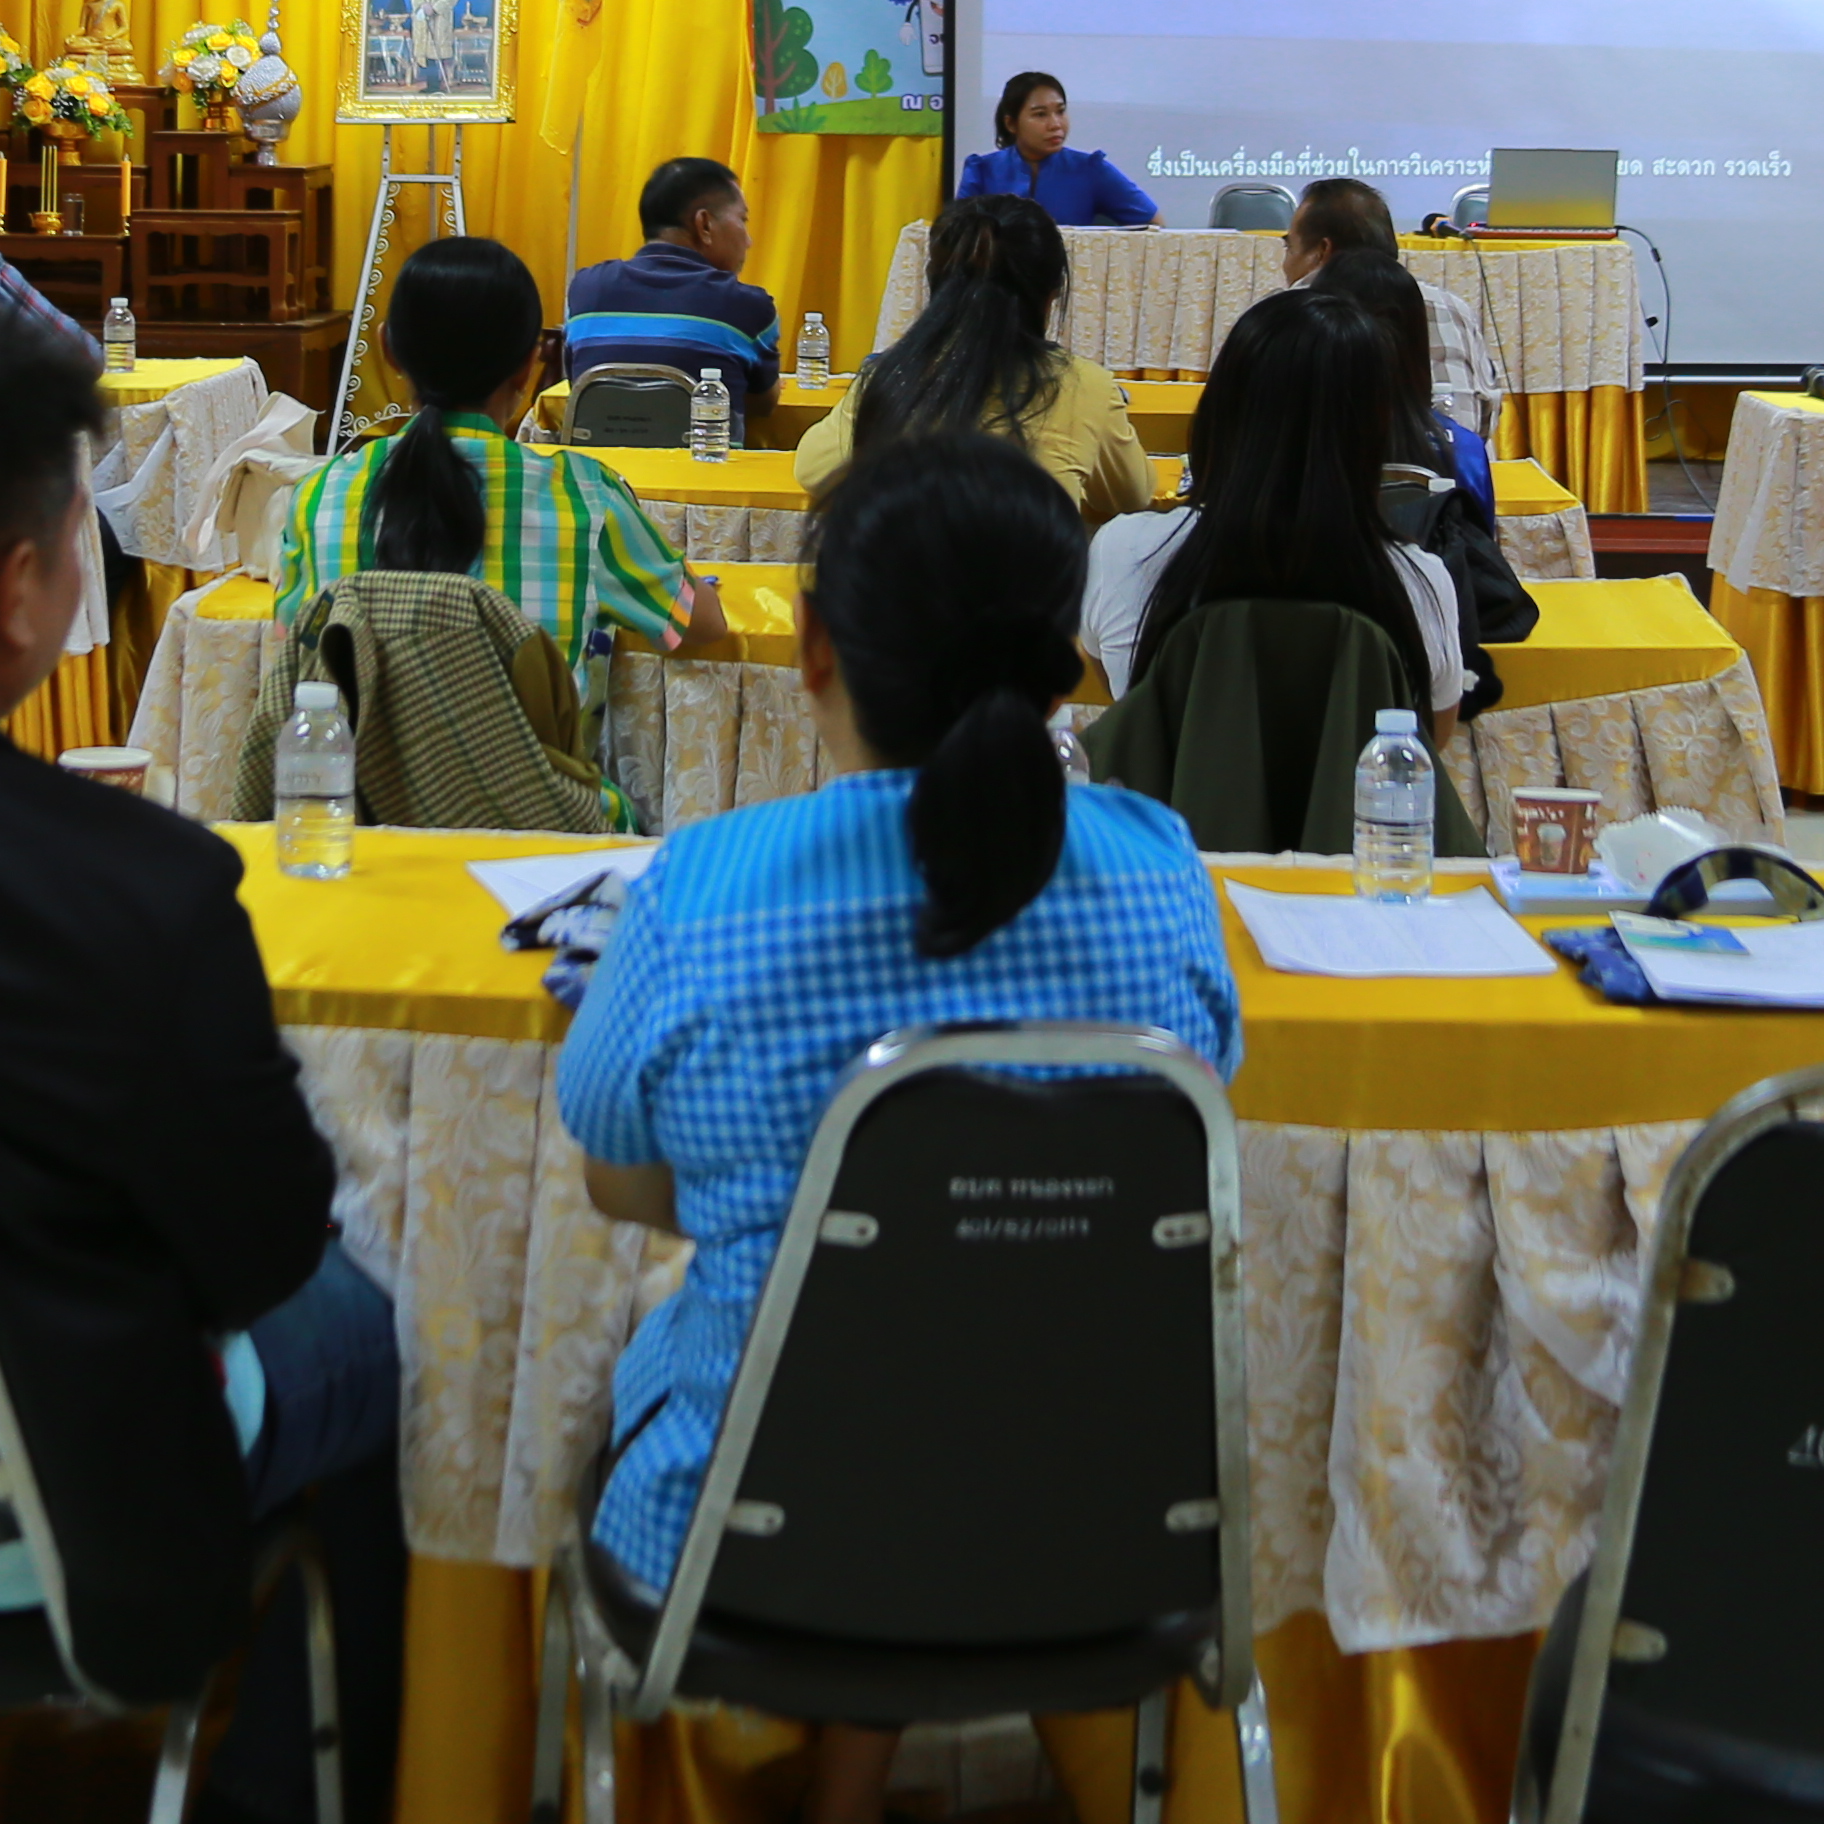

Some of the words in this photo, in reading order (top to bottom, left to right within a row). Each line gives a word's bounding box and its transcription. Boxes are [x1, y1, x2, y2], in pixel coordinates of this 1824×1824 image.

[1652, 157, 1715, 175] สะดวก
[1724, 150, 1791, 176] รวดเร็ว
